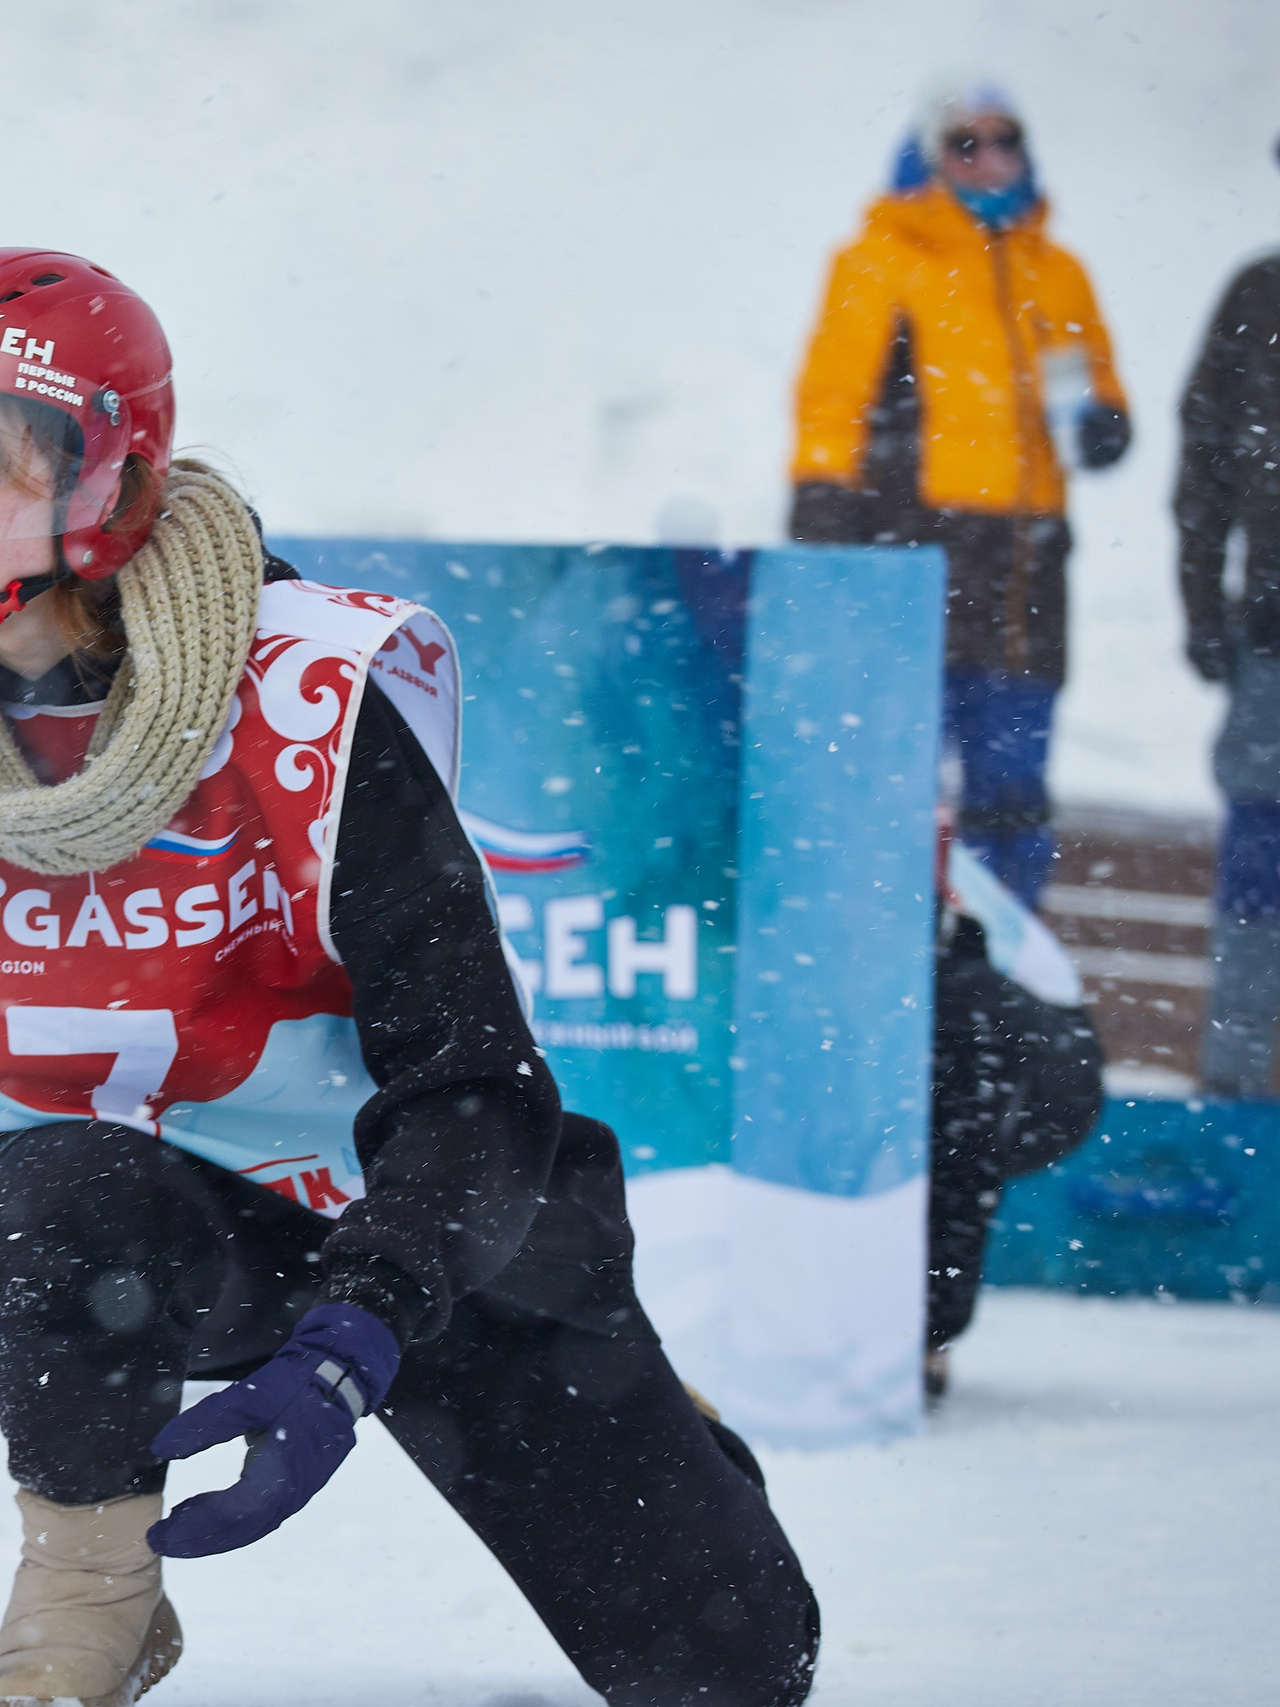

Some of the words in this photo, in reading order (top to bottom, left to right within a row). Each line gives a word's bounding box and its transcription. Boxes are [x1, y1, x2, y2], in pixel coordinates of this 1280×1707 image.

[17, 362, 76, 388] ПЕРВЫЕ
[15, 377, 27, 389] В
[27, 380, 84, 407] РОССИИ
[6, 1005, 179, 1125] 7
